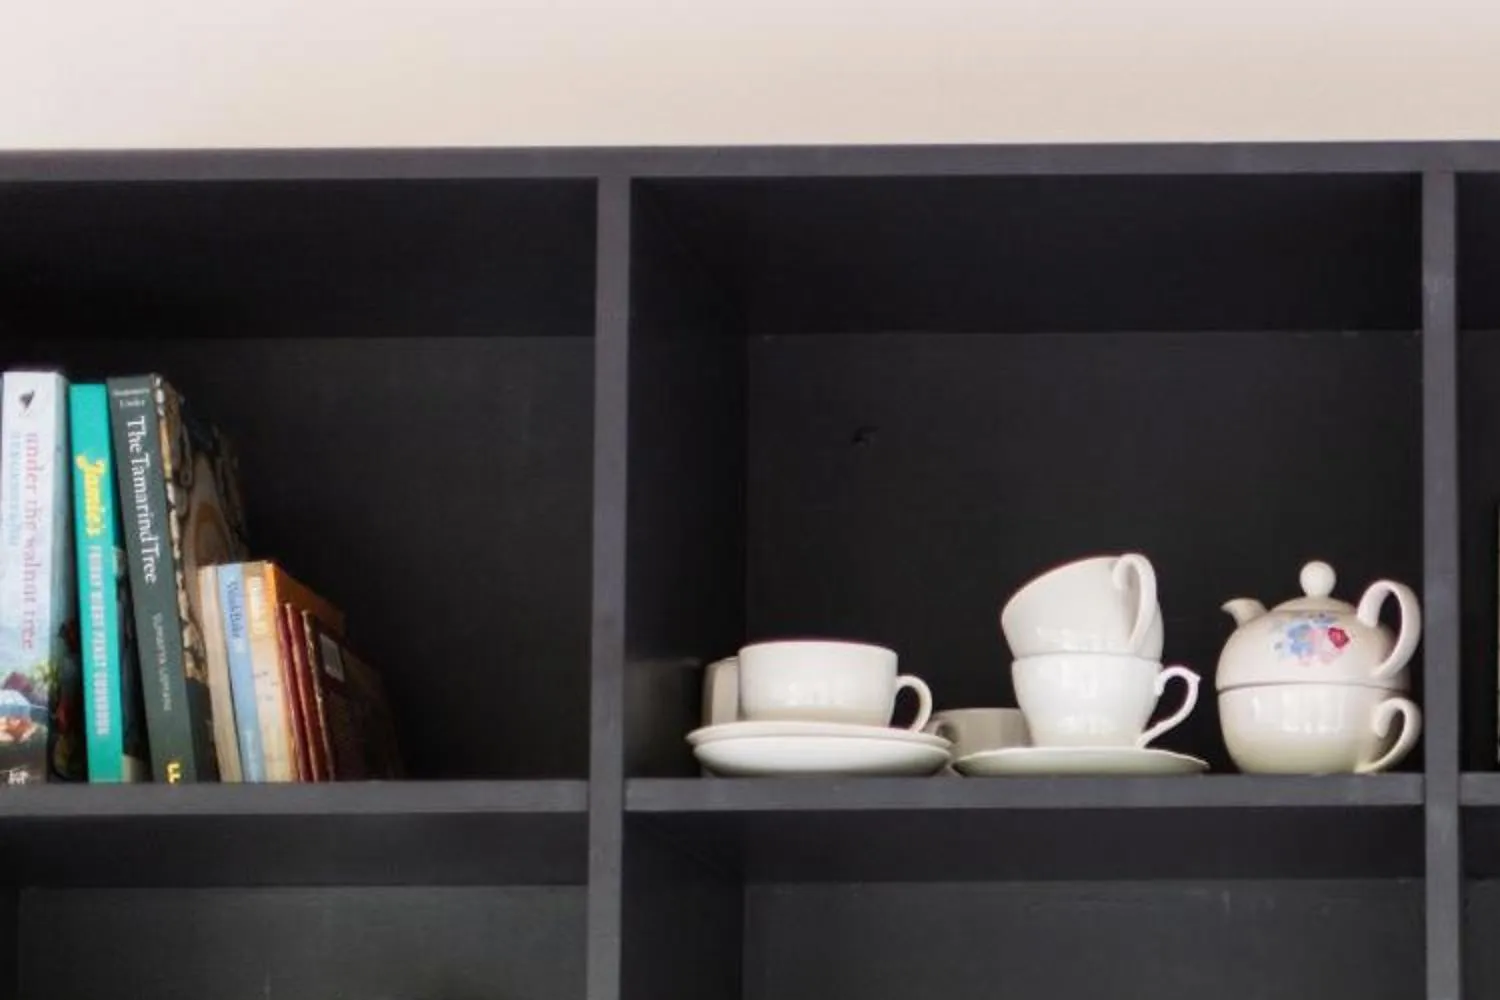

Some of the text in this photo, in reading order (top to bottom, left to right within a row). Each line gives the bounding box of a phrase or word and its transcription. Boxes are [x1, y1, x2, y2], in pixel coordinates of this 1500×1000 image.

[127, 415, 147, 453] The
[76, 454, 107, 538] Jamie's
[131, 452, 160, 543] Tamarind
[21, 432, 45, 650] under the walnut tree
[143, 542, 161, 584] Tree
